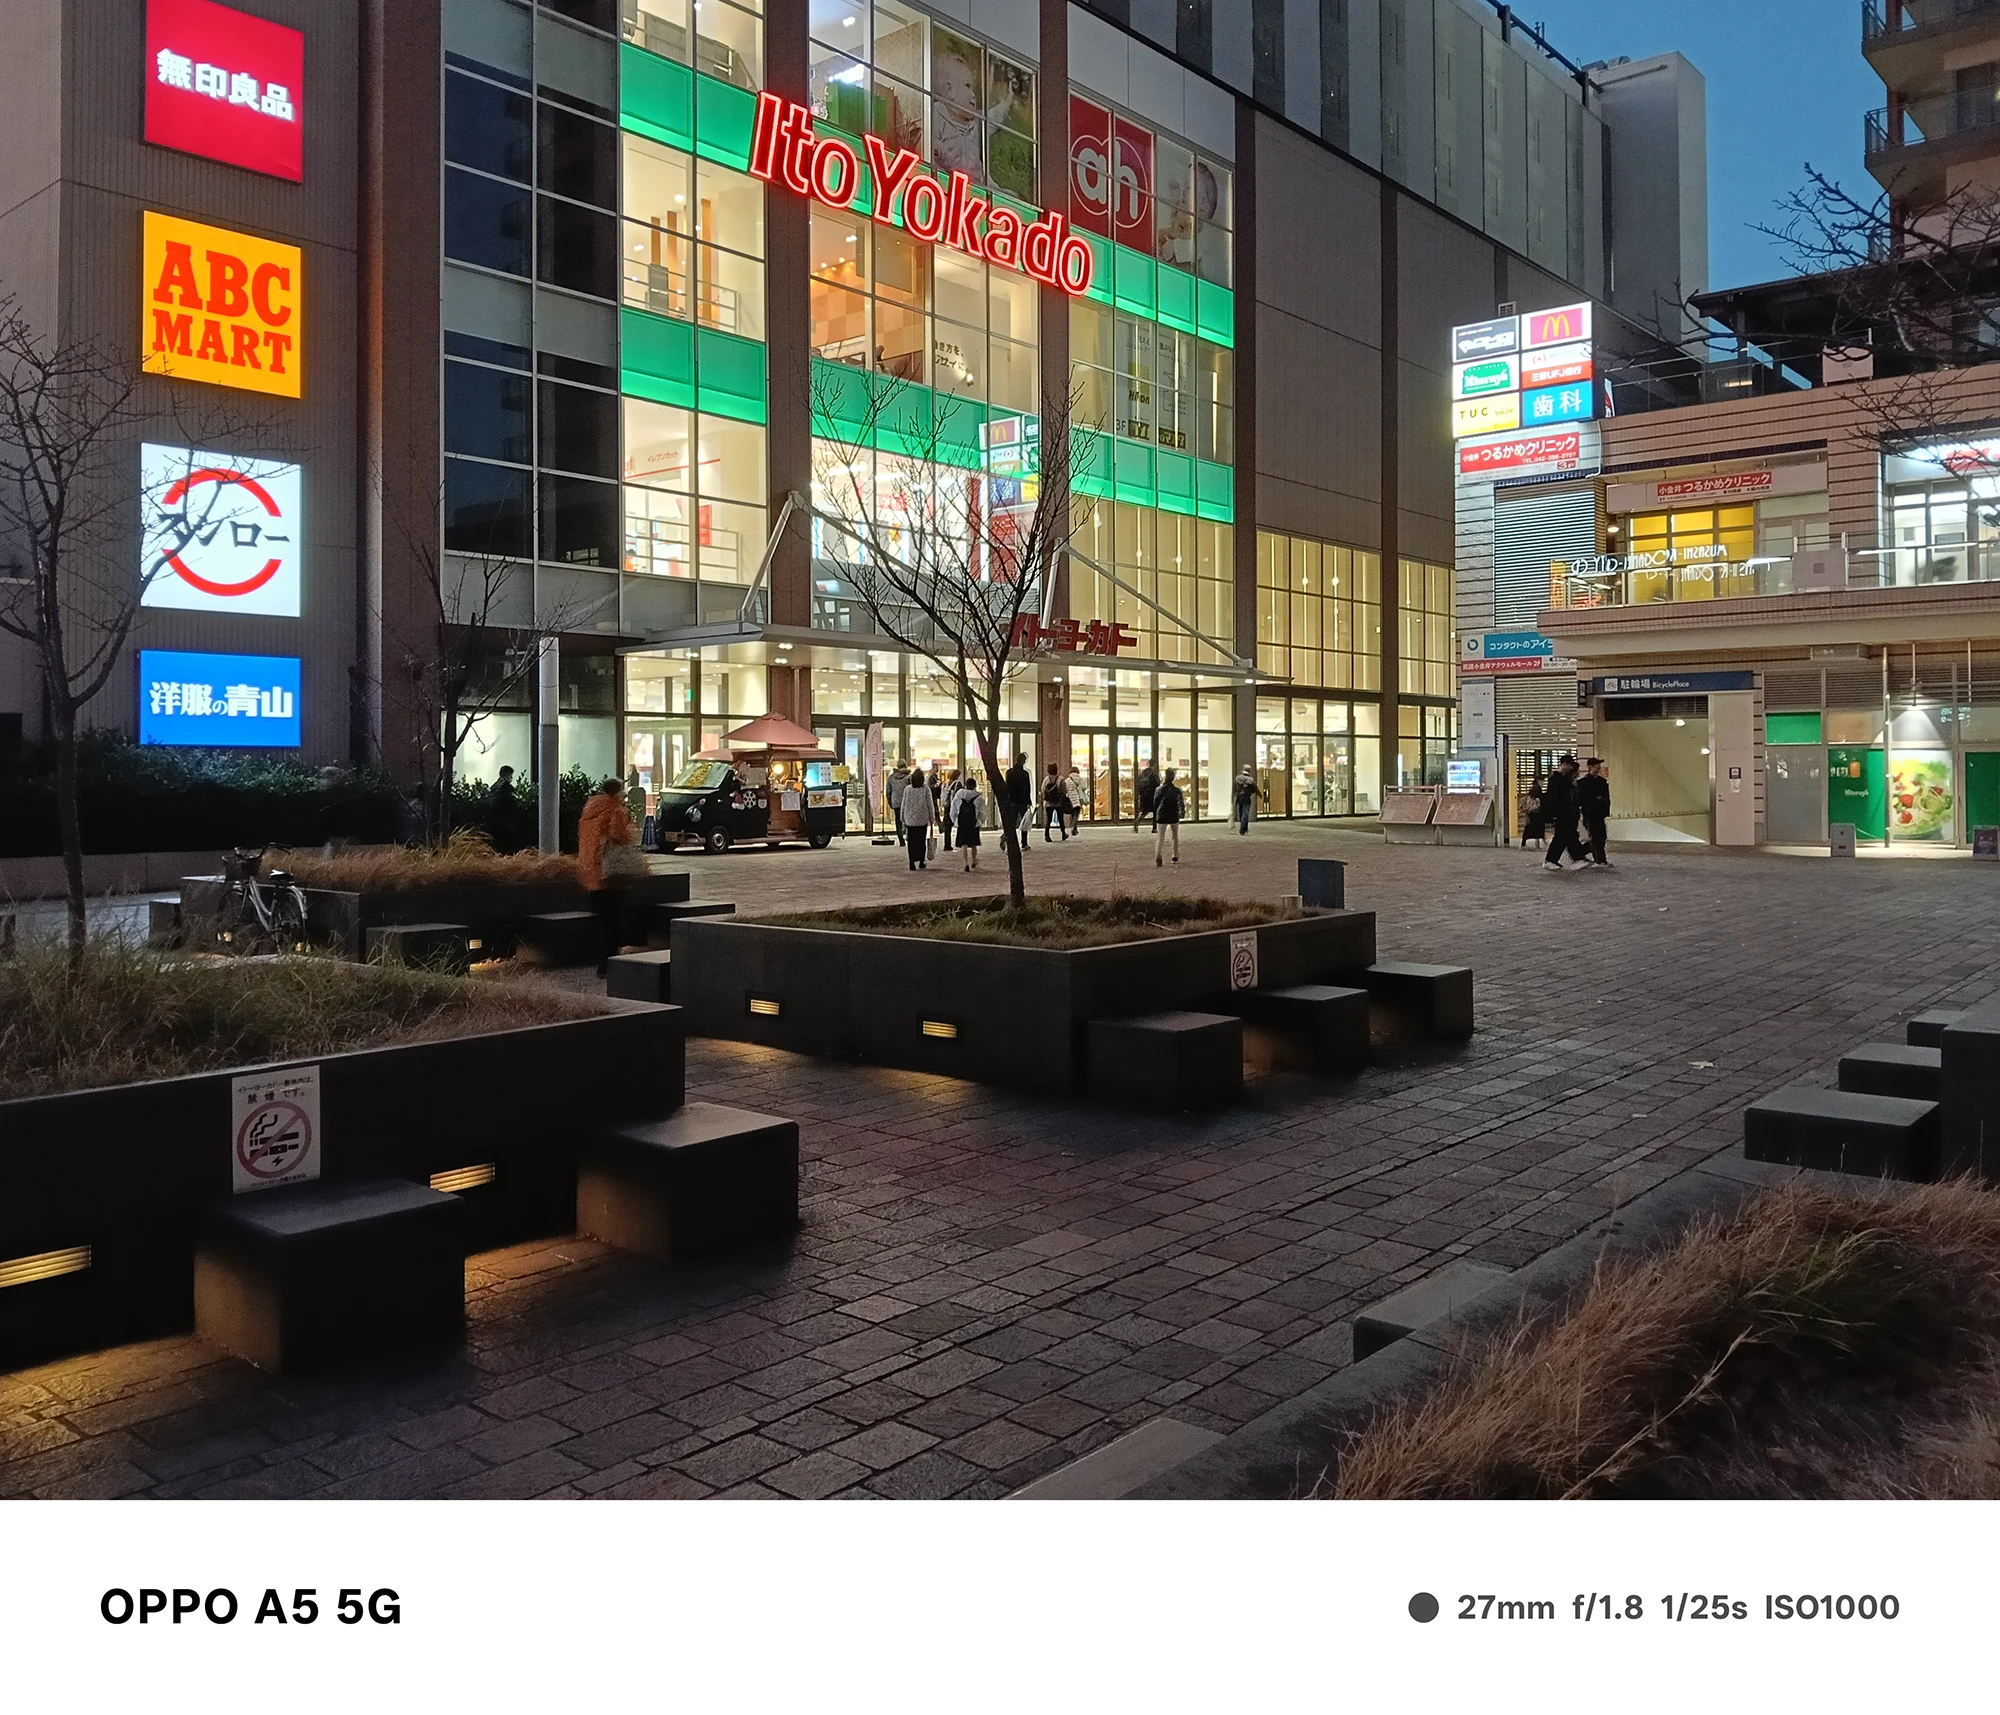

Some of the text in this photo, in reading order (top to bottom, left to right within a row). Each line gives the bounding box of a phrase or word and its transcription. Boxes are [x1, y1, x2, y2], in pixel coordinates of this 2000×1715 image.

[157, 48, 294, 121] 無印良品
[750, 91, 1094, 296] Ito Yokado
[153, 240, 291, 327] ABC
[152, 308, 291, 374] MART
[1460, 407, 1488, 420] TUC
[1532, 389, 1583, 418] 歯科
[1481, 436, 1577, 461] つるかめクリニック
[1659, 473, 1771, 495] 小金井 つるかめクリニック
[149, 681, 293, 718] 洋服の青山
[1620, 679, 1650, 690] 駐輪場
